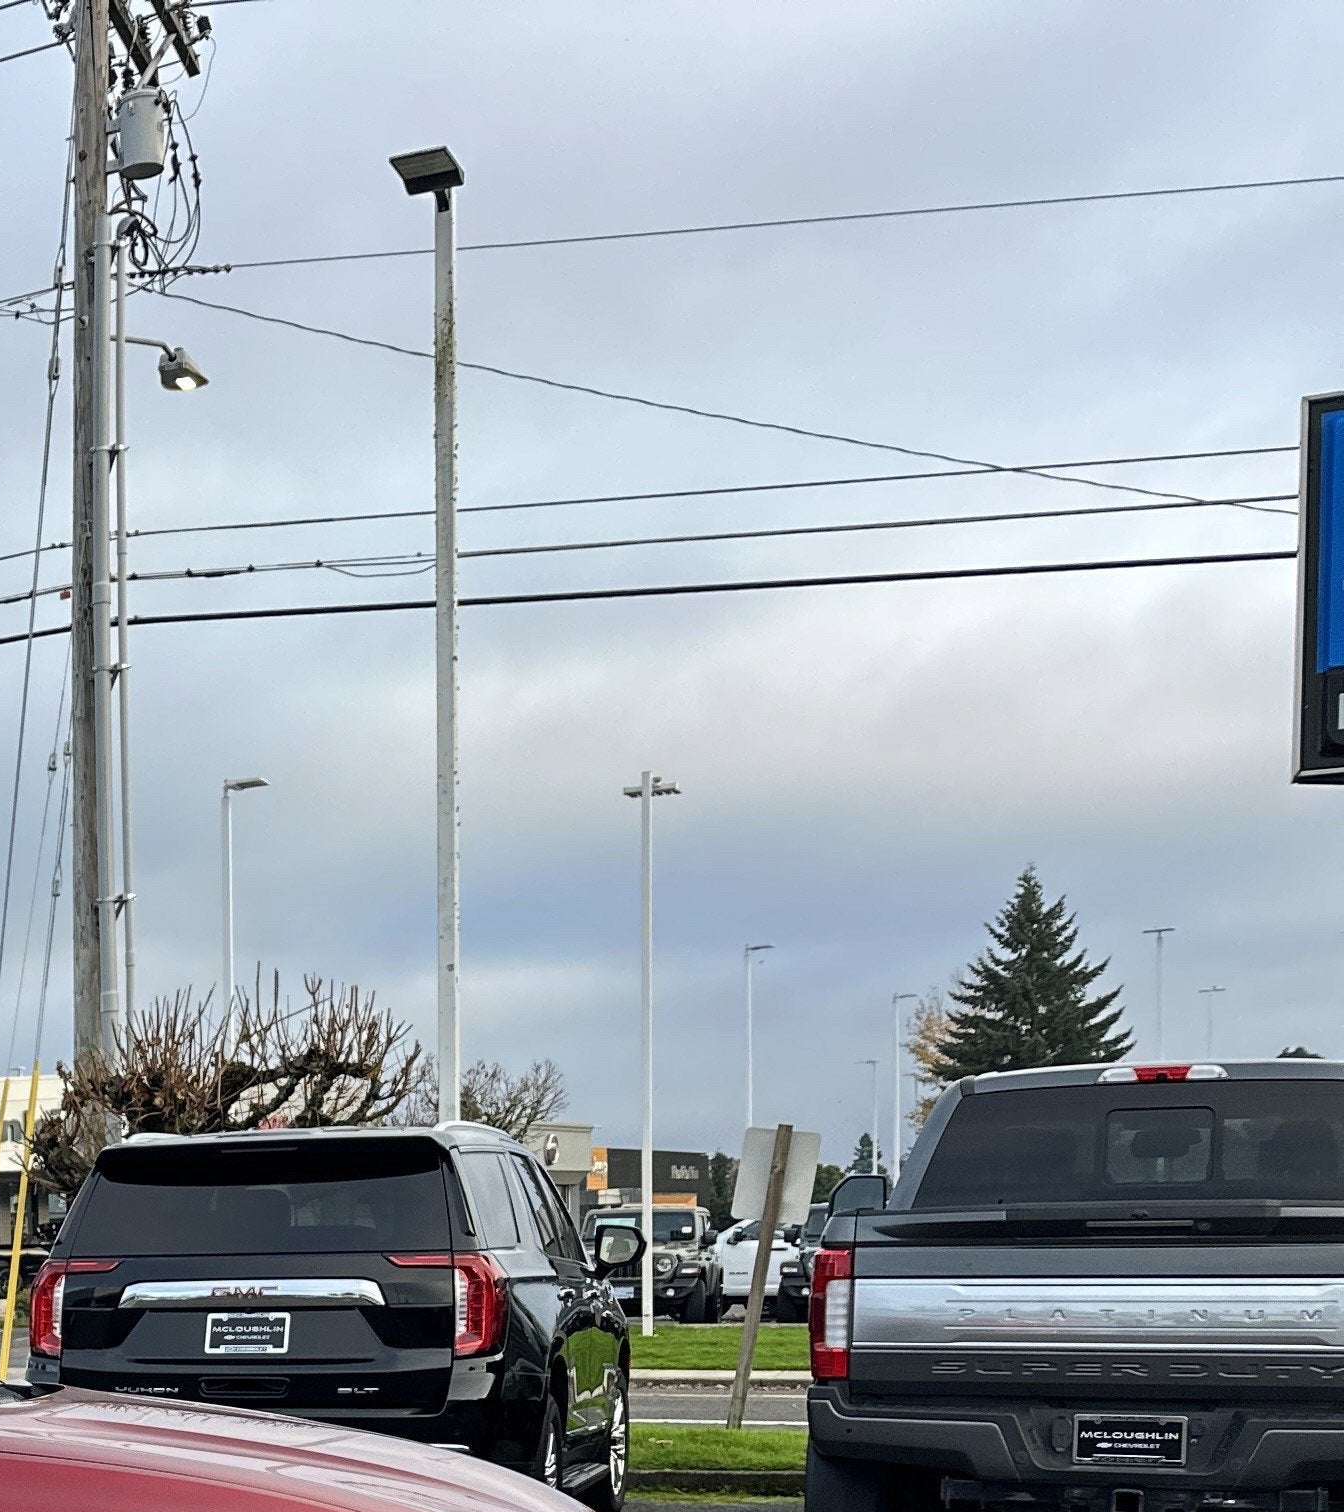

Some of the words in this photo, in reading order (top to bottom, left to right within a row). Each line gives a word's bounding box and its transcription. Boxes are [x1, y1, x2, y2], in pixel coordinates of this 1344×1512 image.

[212, 1286, 279, 1300] GMC
[958, 1308, 1323, 1322] PLATINUM
[211, 1325, 284, 1333] MCLOUGHLIN
[930, 1360, 1149, 1378] SUPER
[1168, 1362, 1343, 1380] DUTY
[1079, 1431, 1180, 1440] MCLOUGHLIN
